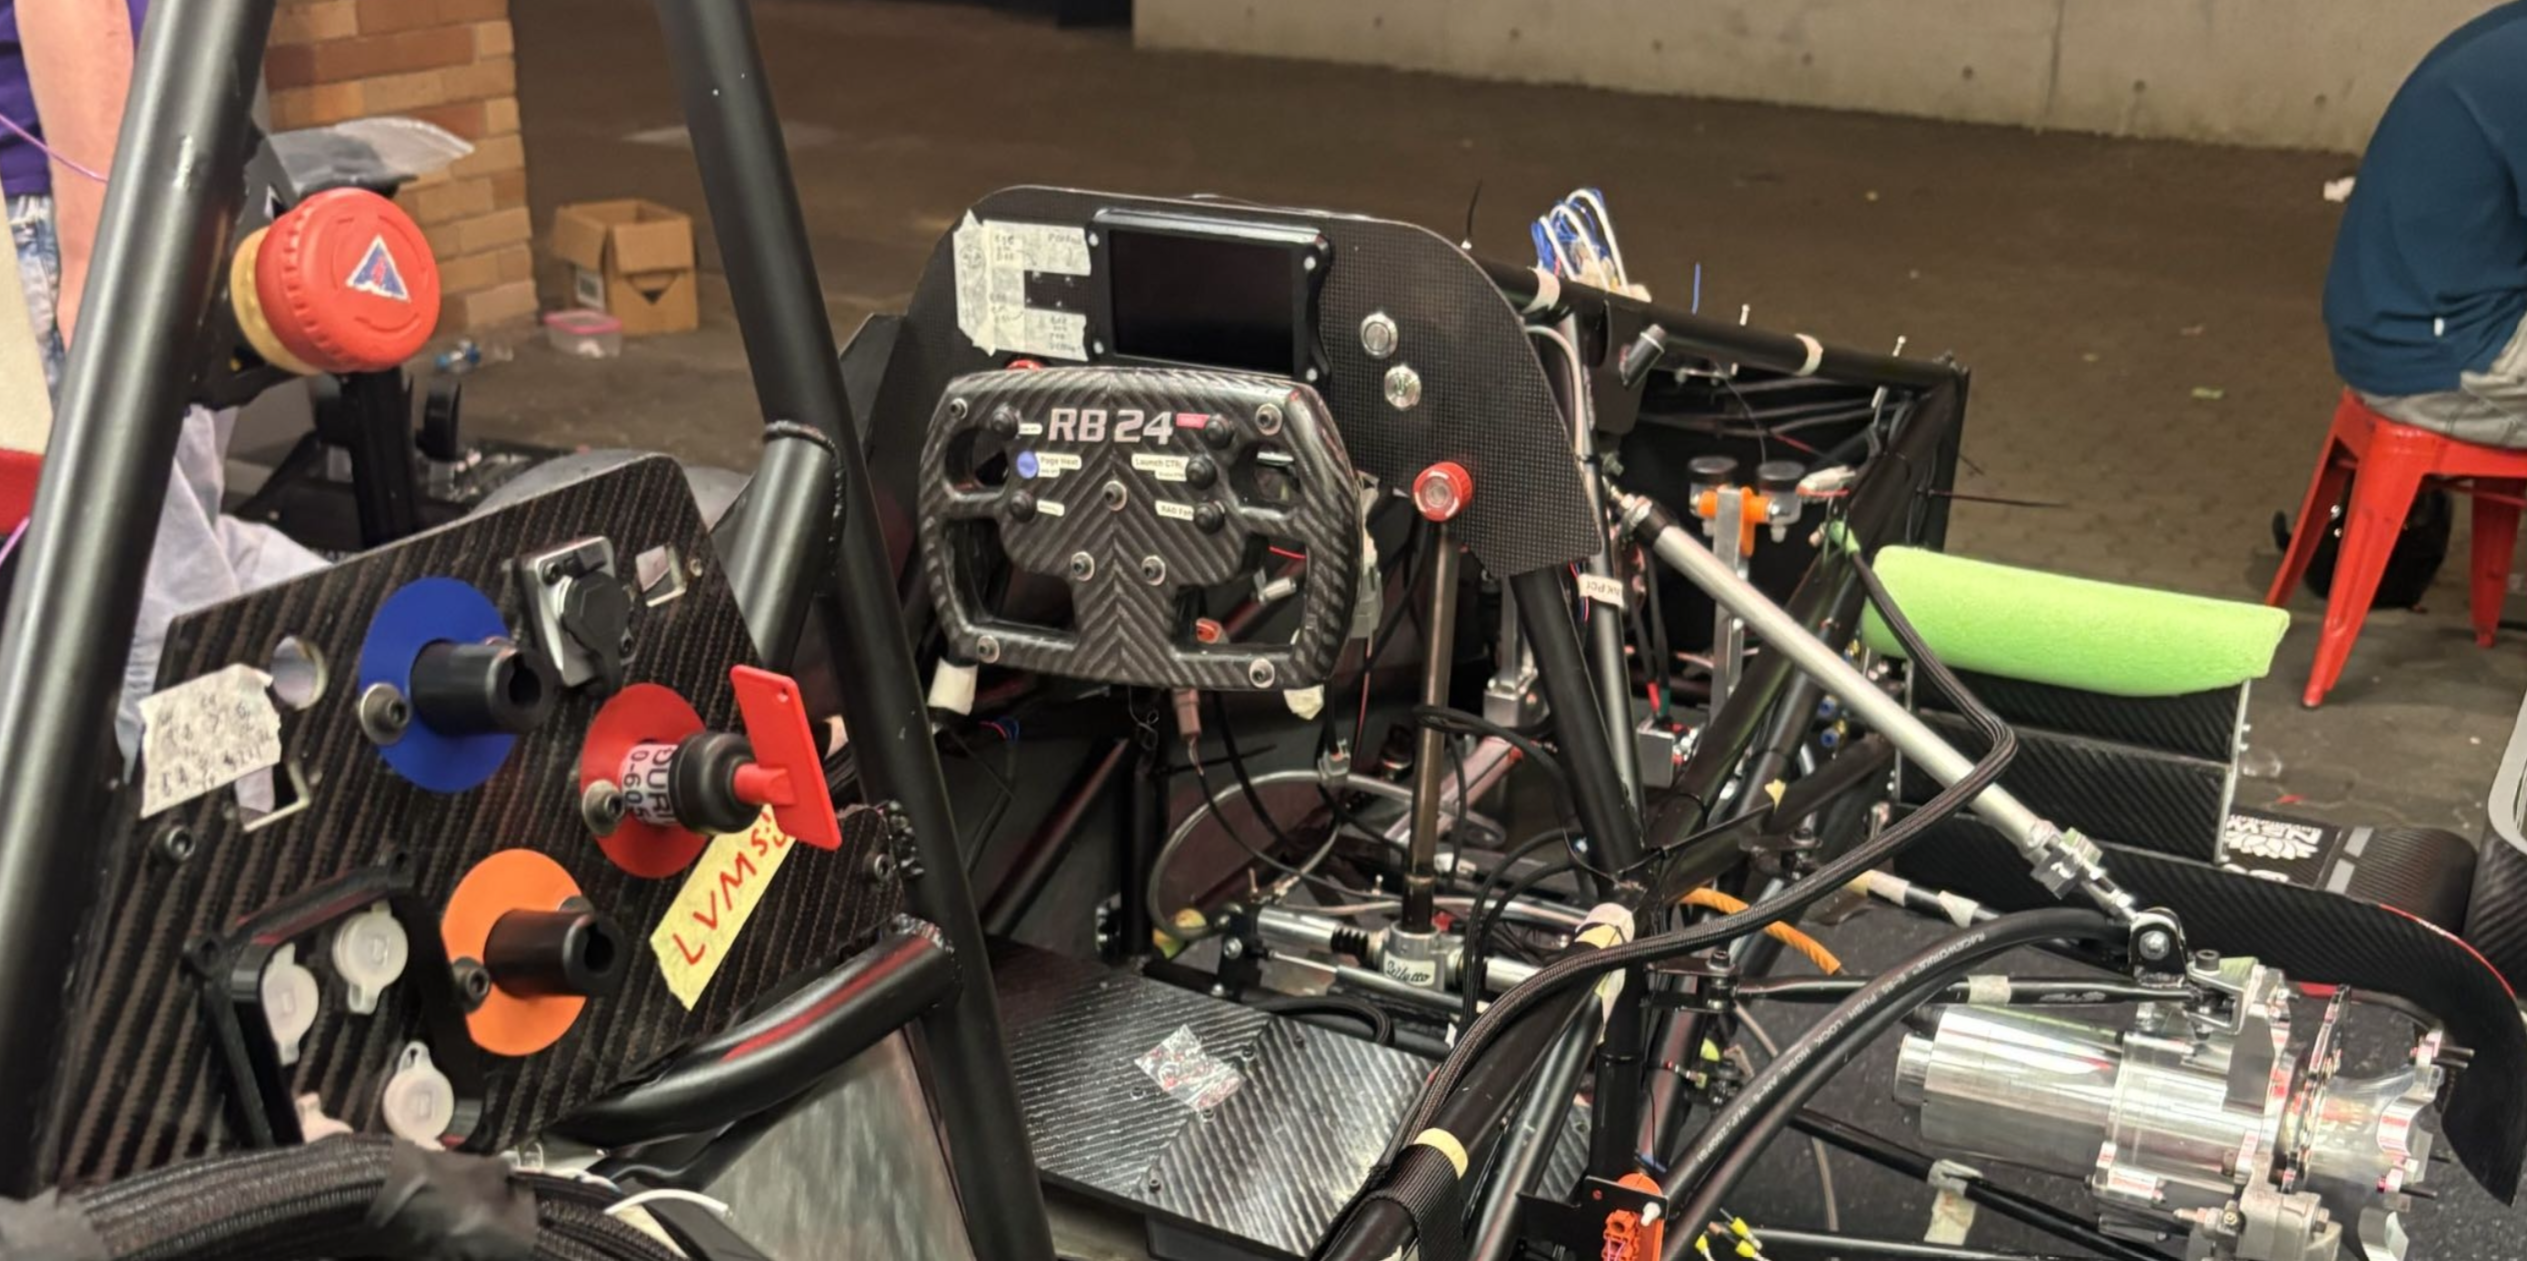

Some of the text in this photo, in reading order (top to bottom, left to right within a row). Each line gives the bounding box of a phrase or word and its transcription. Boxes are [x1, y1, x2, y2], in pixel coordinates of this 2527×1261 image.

[1847, 992, 1878, 1020] PUSH
[1814, 1018, 1844, 1046] LOCK
[1780, 1046, 1812, 1076] HOSE
